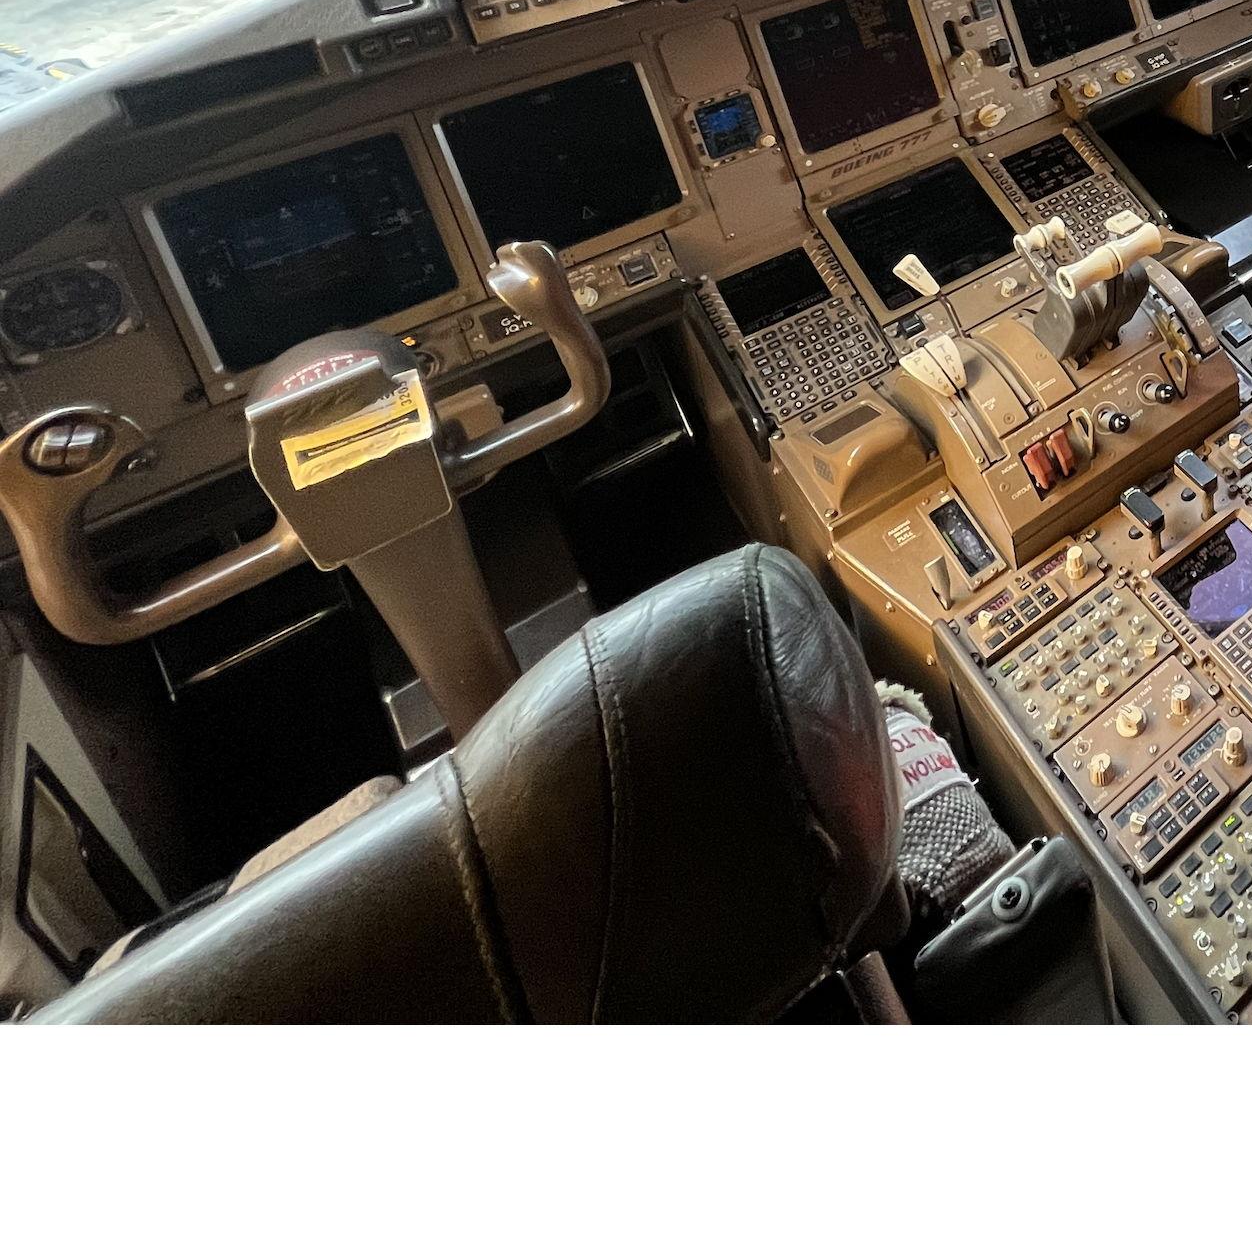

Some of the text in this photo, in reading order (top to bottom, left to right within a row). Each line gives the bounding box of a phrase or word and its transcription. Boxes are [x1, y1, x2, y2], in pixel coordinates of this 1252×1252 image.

[831, 130, 932, 180] BOEING 777
[1001, 462, 1019, 475] NORM
[1011, 483, 1033, 501] CUTOUT
